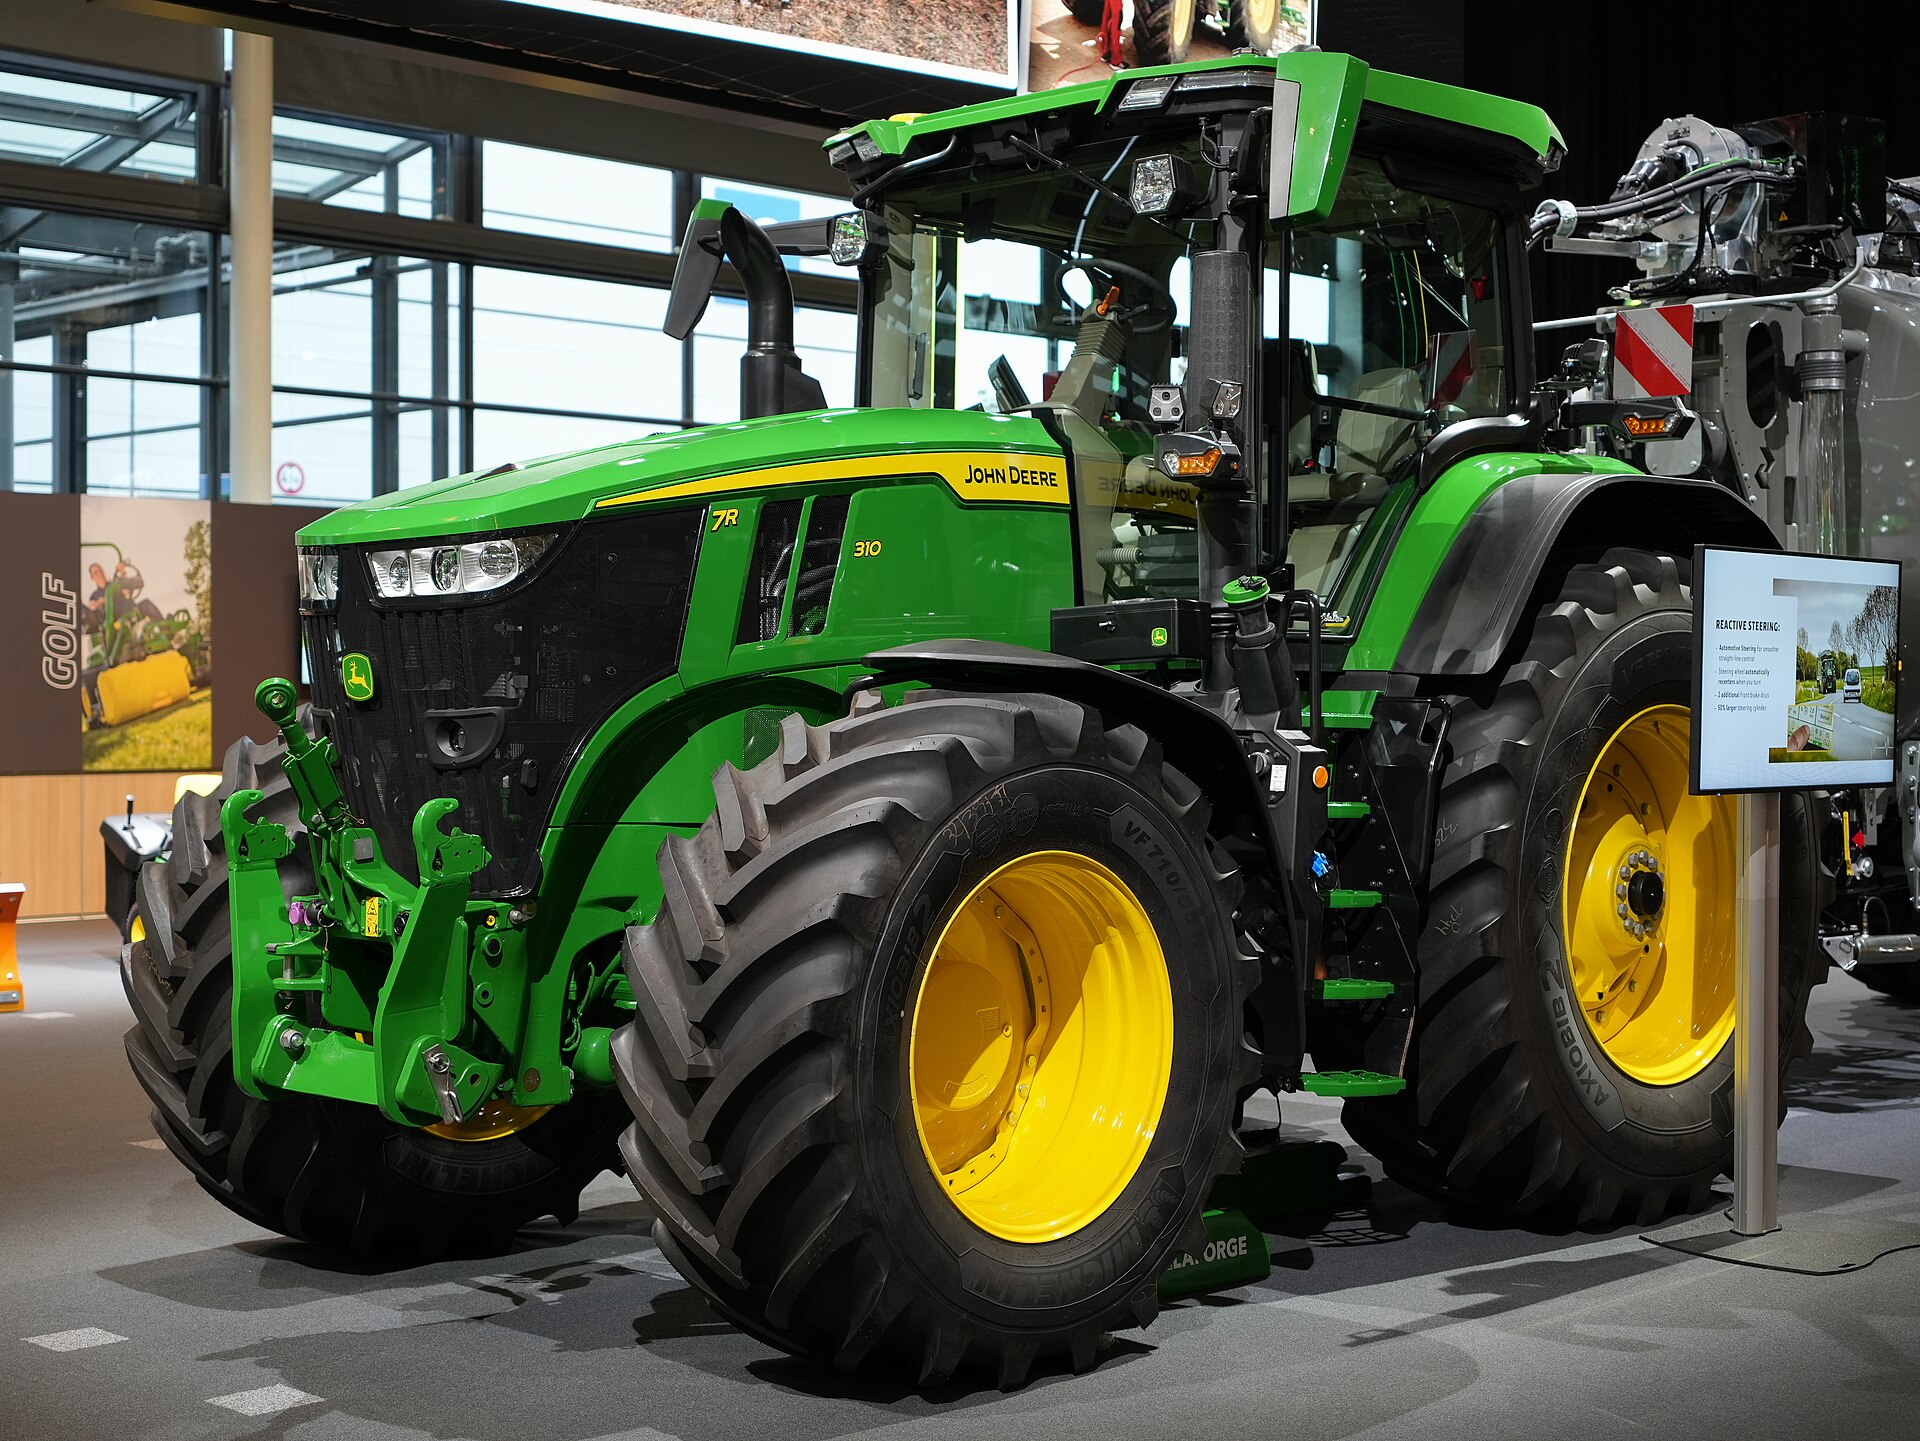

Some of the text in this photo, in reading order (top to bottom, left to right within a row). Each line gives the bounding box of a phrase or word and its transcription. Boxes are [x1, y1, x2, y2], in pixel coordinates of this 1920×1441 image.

[965, 464, 1059, 487] JOHN DEERE
[711, 508, 739, 532] 7R
[853, 540, 882, 557] 310
[42, 571, 78, 690] GOLF
[1715, 619, 1781, 632] REACTIVE STEERING:
[1740, 644, 1757, 653] Steering
[1745, 669, 1770, 677] automatically
[1541, 958, 1610, 1107] AXIOBIB 2
